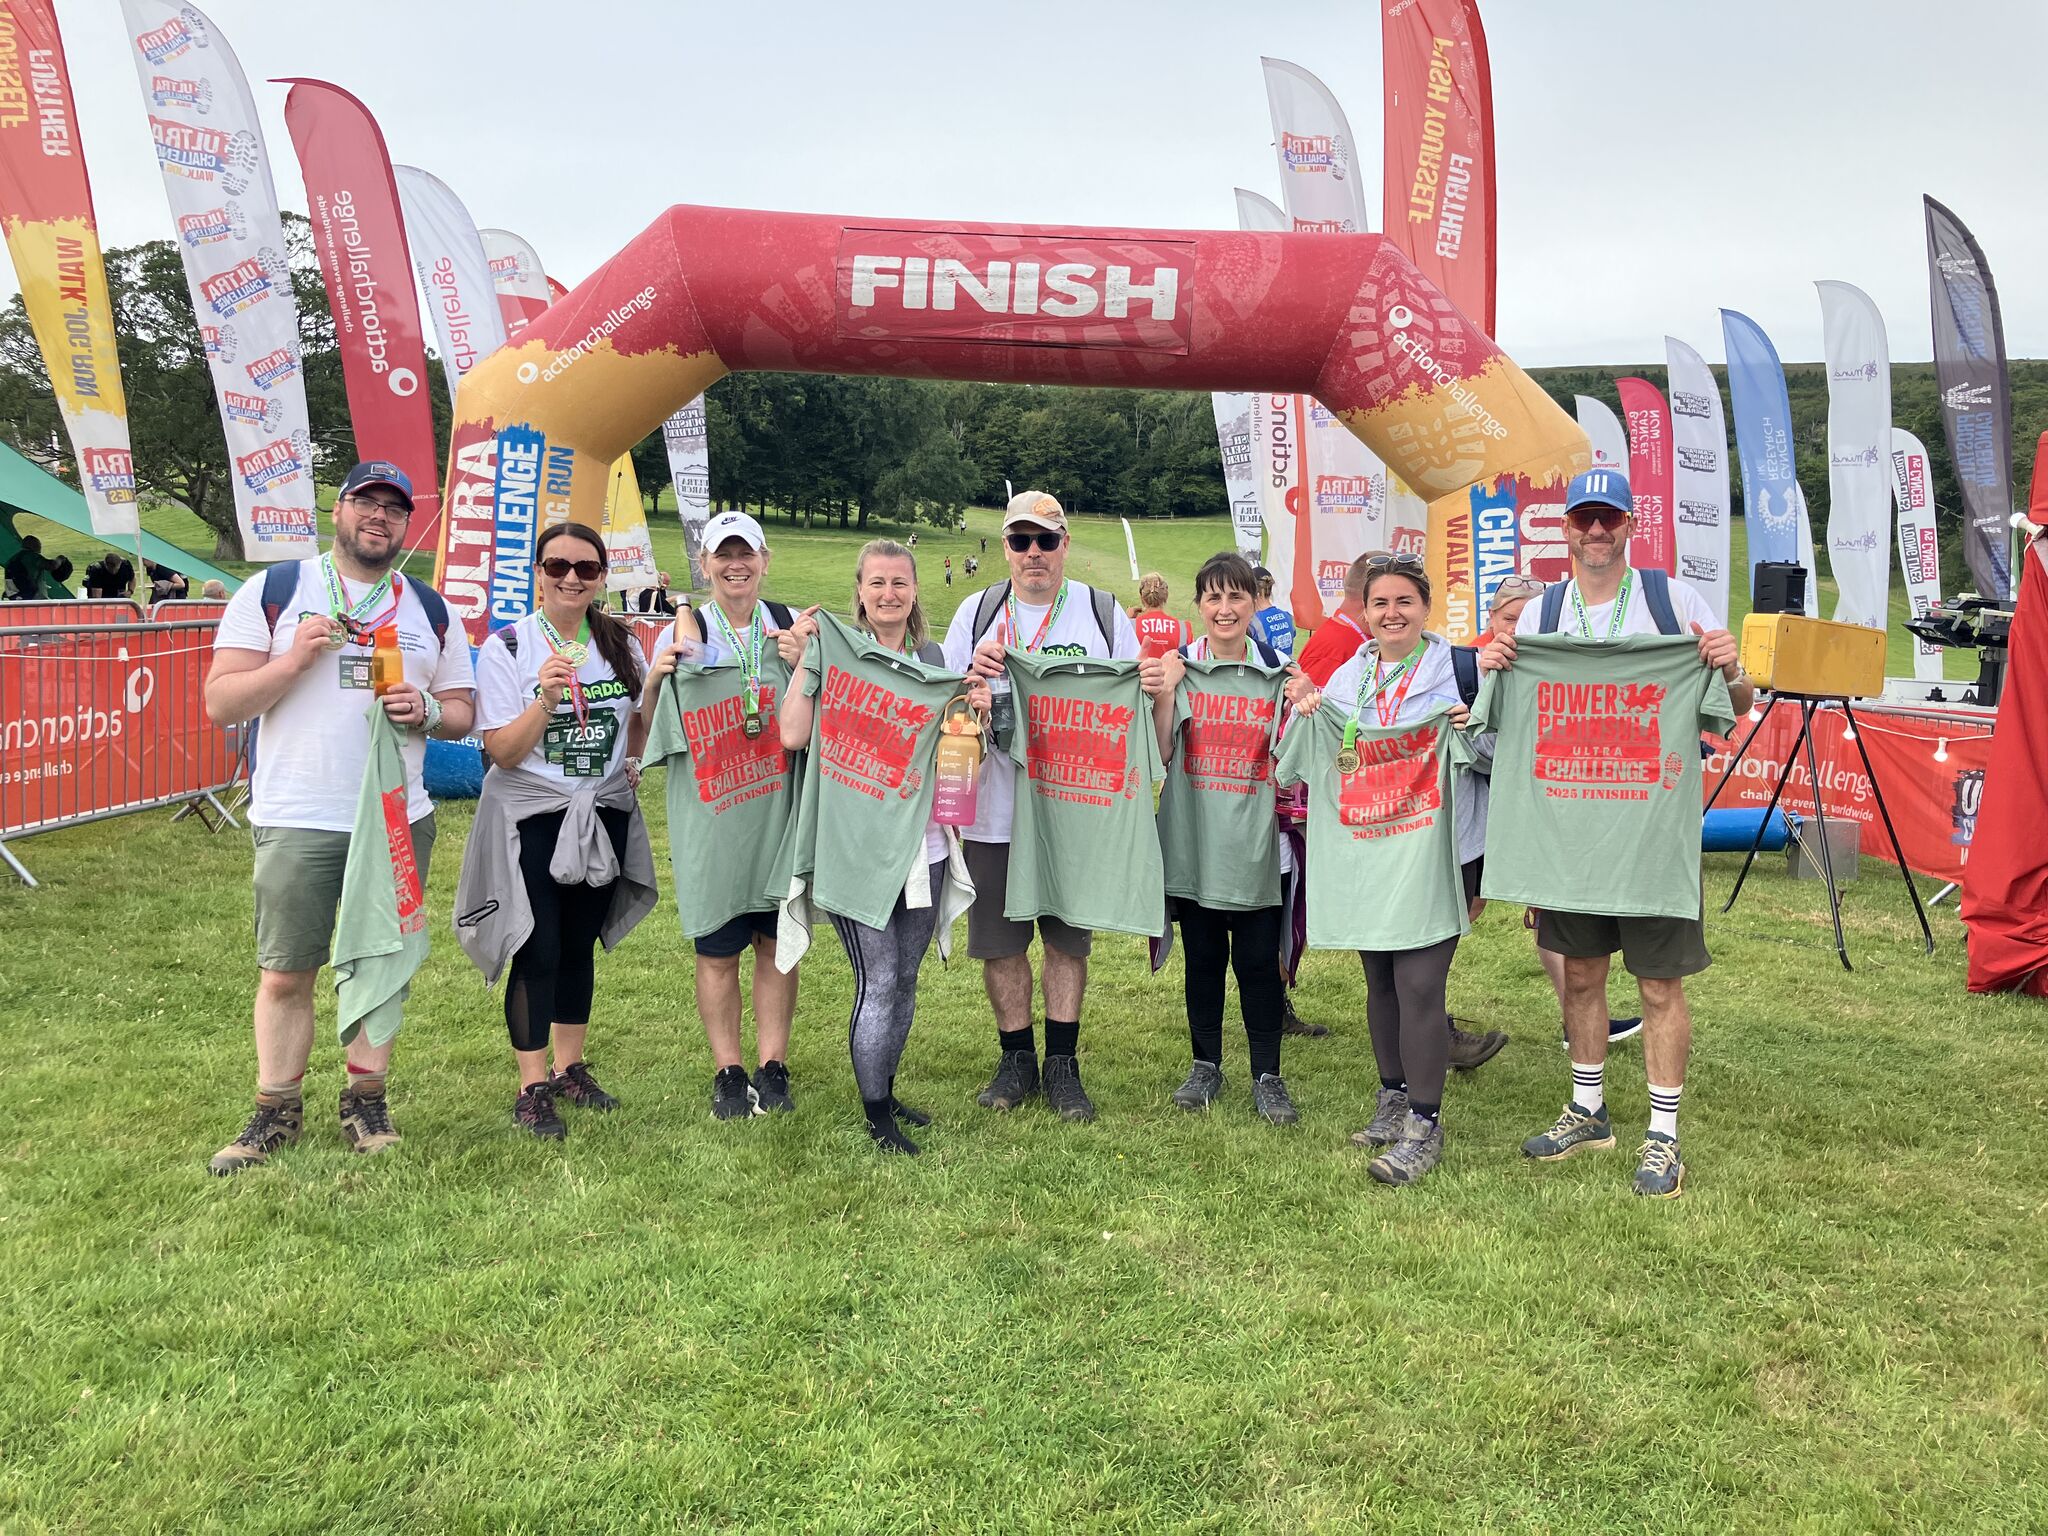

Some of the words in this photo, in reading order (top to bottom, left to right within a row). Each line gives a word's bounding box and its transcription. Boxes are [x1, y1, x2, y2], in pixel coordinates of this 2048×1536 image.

[851, 254, 1178, 321] FINISH
[541, 284, 657, 383] actionchallenge
[1393, 331, 1508, 440] actionchallenge
[444, 440, 498, 620] ULTRA
[491, 441, 539, 621] CHALLENGE
[1614, 587, 1627, 623] CHALLENGE
[1141, 618, 1175, 634] STAFF
[826, 664, 896, 720] GOWER
[1538, 682, 1618, 715] GOWER
[683, 695, 744, 740] GOWER
[1028, 694, 1094, 729] GOWER
[563, 725, 606, 743] 7205
[1538, 714, 1660, 743] PENINSULA
[837, 731, 878, 756] ULTRA
[1206, 746, 1247, 757] ULTRA
[1572, 746, 1623, 757] ULTRA
[721, 750, 757, 769] ULTRA
[1053, 752, 1095, 766] ULTRA
[1545, 759, 1650, 782] CHALLENGE
[708, 754, 780, 800] CHALLENGE
[832, 770, 885, 801] FINISHER
[1036, 761, 1115, 790] CHALLENGE
[1036, 783, 1056, 798] 2025
[1058, 791, 1113, 807] FINISHER
[1372, 786, 1412, 801] ULTRA
[1545, 787, 1577, 798] 2025
[1582, 788, 1649, 801] FINISHER
[1349, 793, 1433, 825] CHALLENGE
[1792, 800, 1828, 812] evens
[1831, 805, 1874, 823] worldwide
[1352, 826, 1382, 840] 2025
[1384, 815, 1434, 838] FINISHER
